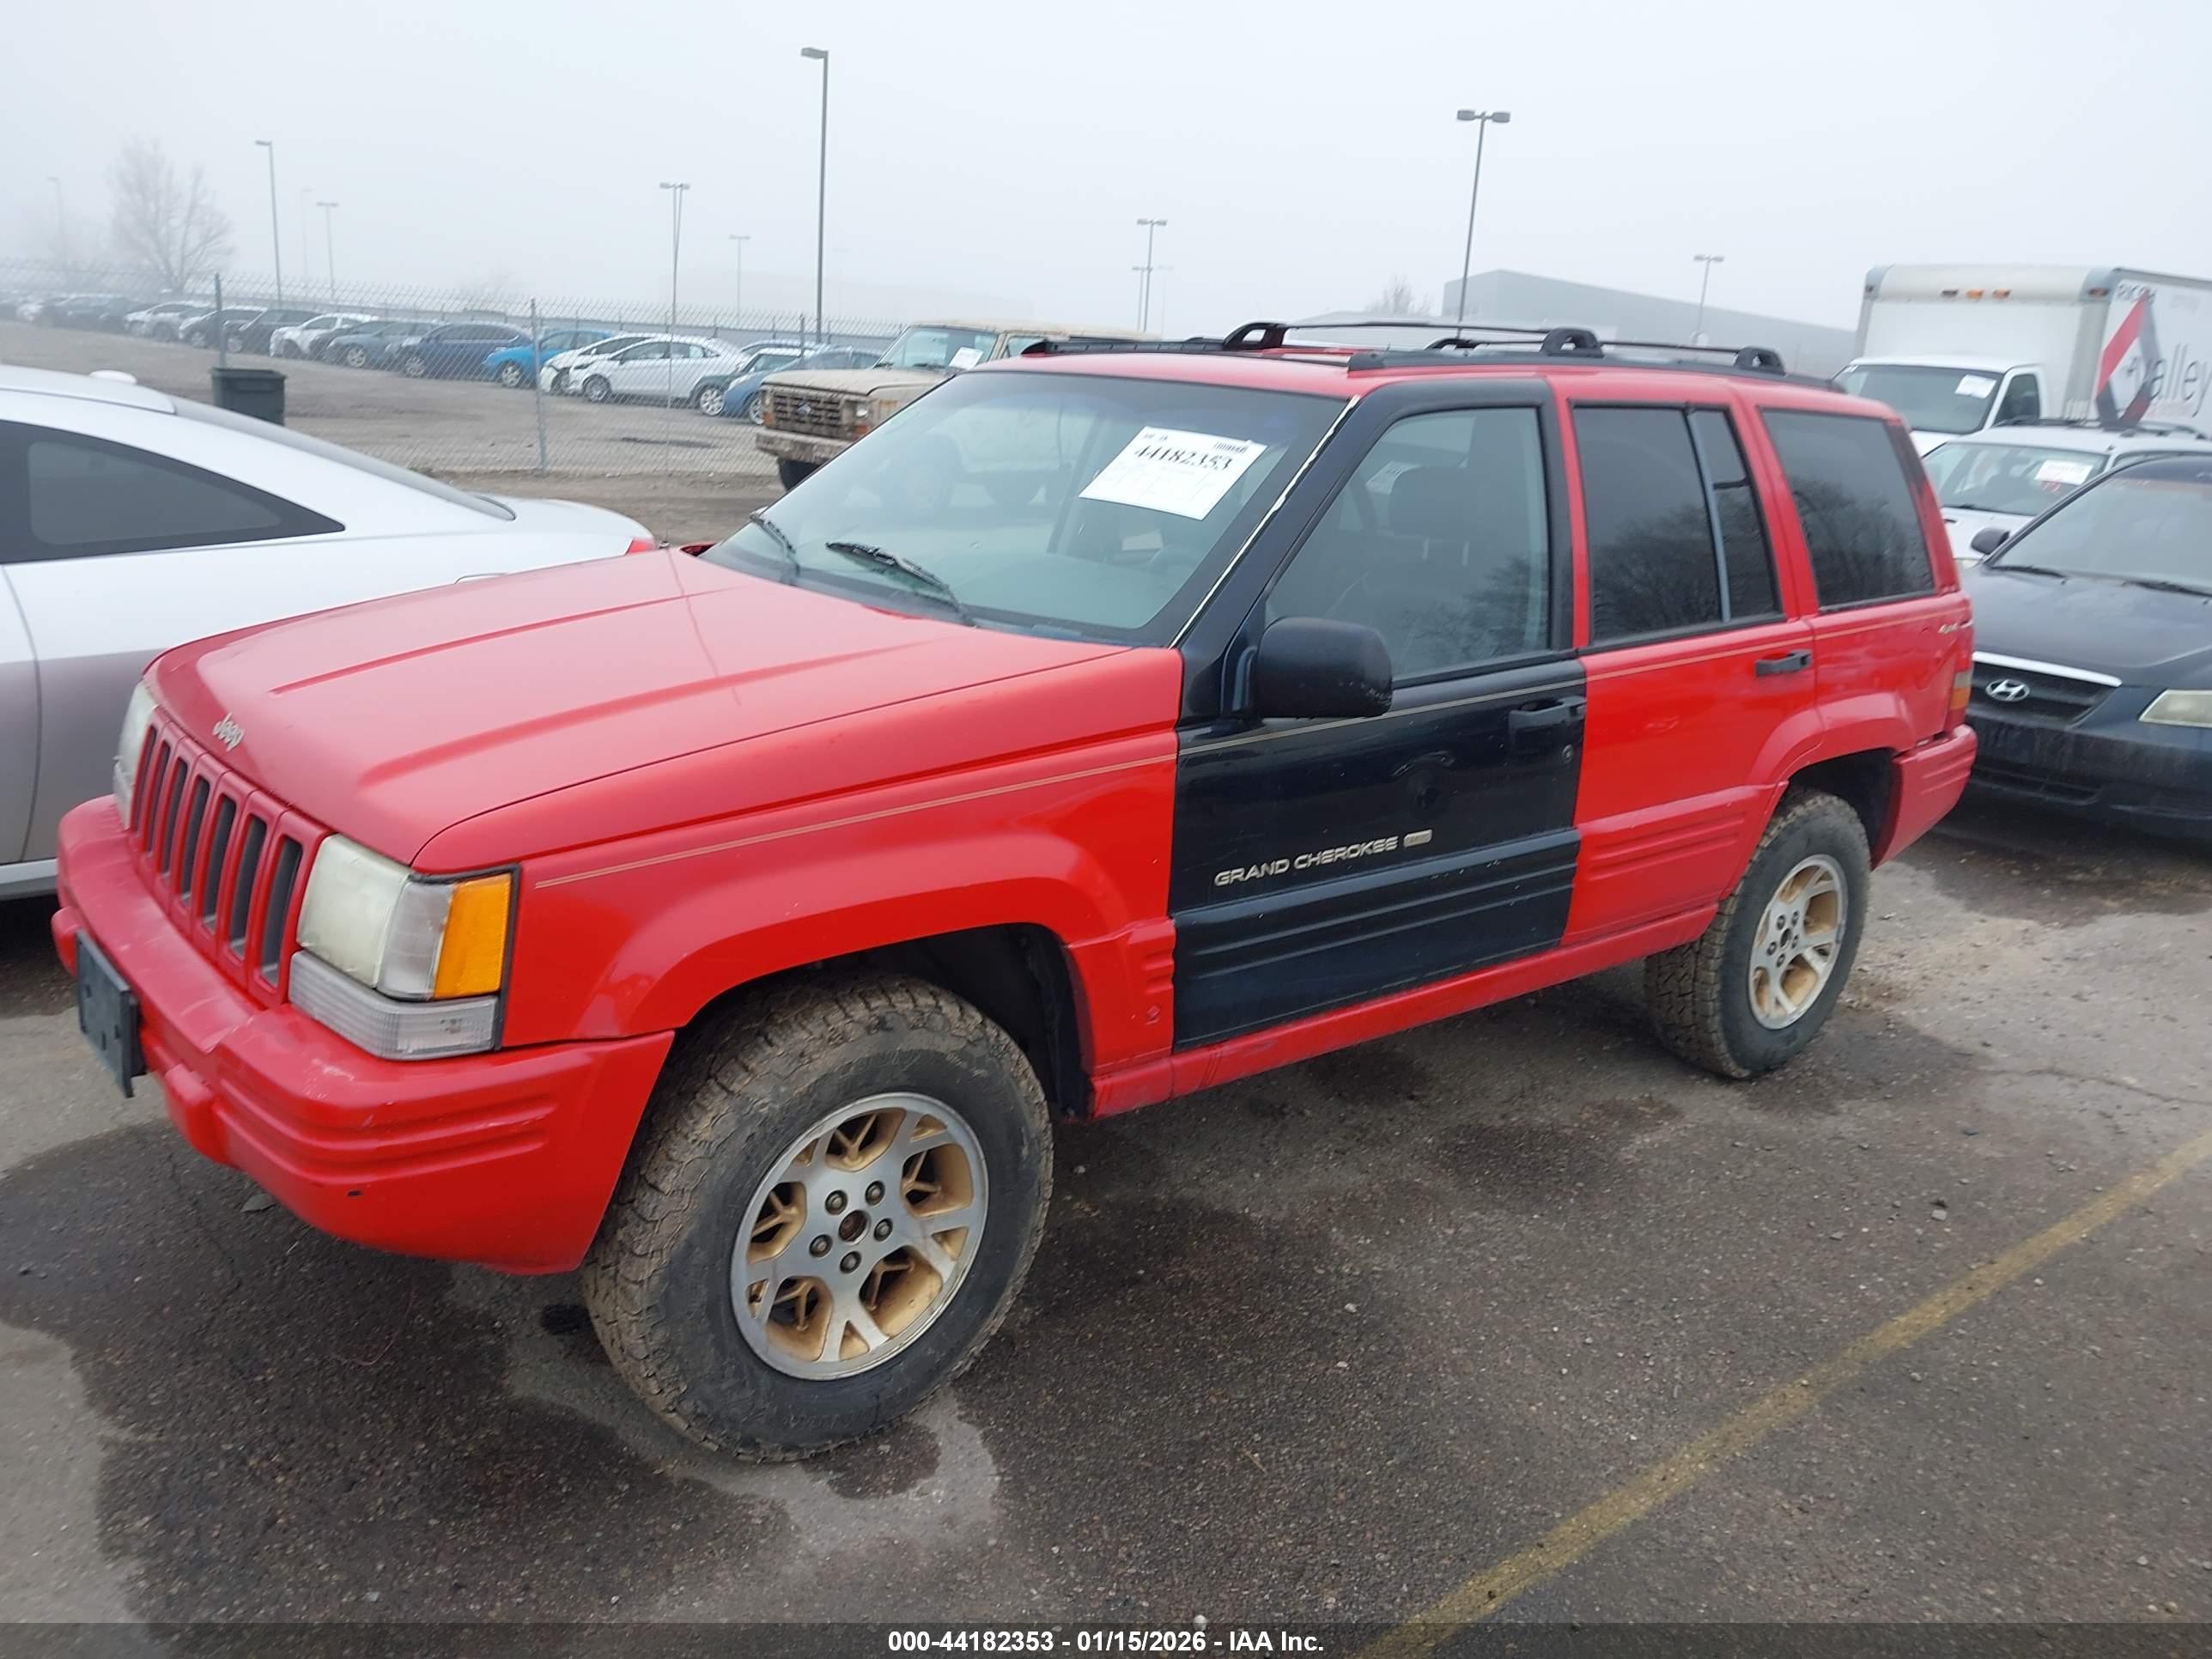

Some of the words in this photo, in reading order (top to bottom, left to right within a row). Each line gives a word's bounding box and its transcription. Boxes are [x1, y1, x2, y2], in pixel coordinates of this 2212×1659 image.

[1134, 445, 1234, 471] 44182353
[212, 712, 246, 752] Jeep
[1214, 858, 1291, 887] GRAND
[1293, 836, 1400, 870] CHEROKEE
